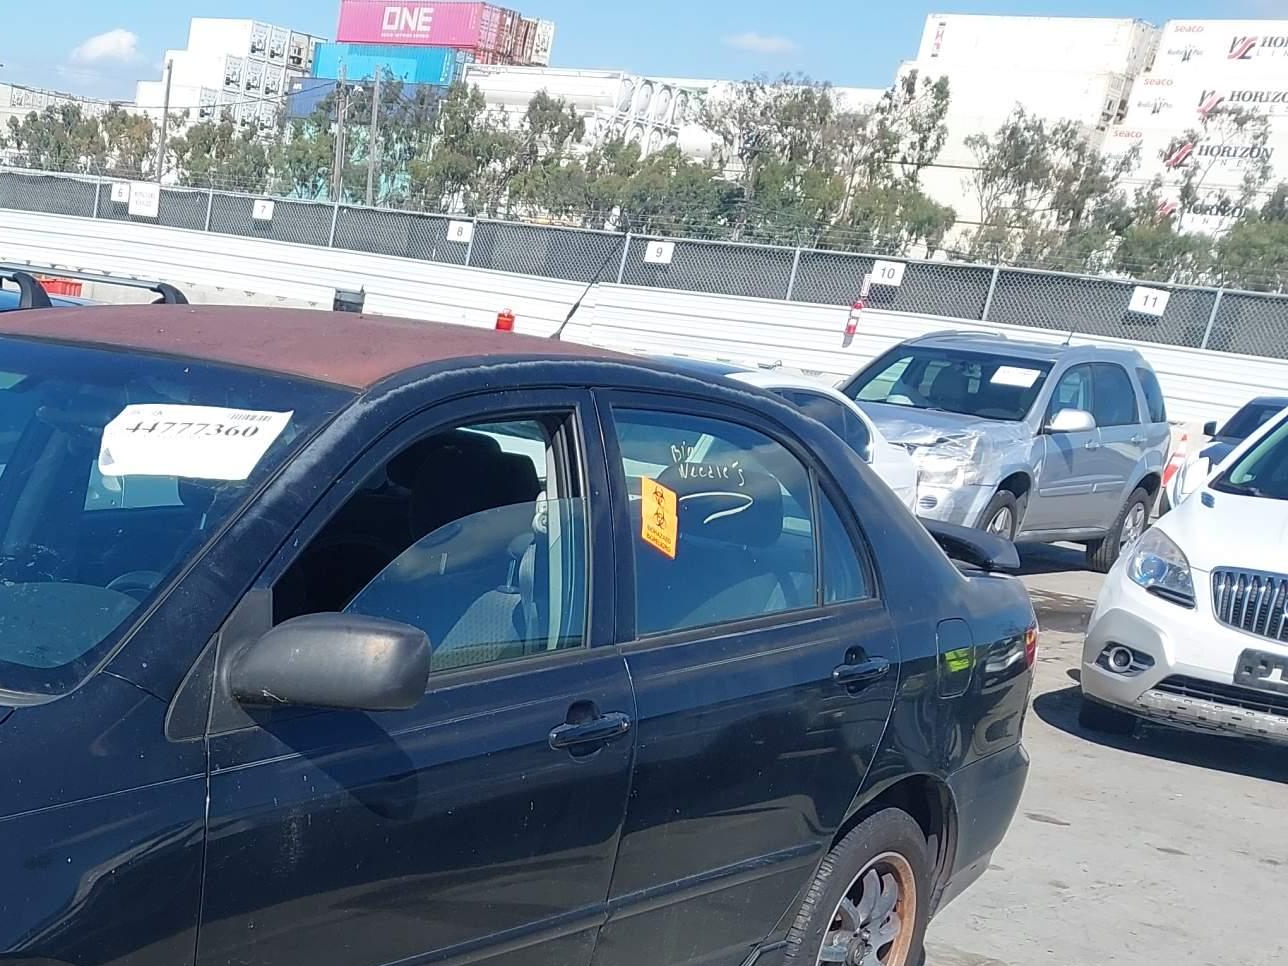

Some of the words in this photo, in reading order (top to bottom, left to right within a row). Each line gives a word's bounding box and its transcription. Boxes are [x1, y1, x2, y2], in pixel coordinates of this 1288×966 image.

[382, 6, 434, 32] ONE
[1174, 24, 1205, 33] seaco
[1143, 77, 1174, 87] seaco
[1112, 128, 1143, 139] seaco
[261, 205, 267, 214] 7
[456, 226, 464, 236] 8
[655, 247, 663, 258] 9
[881, 267, 896, 279] 10
[1143, 294, 1158, 308] 11
[125, 421, 260, 438] 44777360
